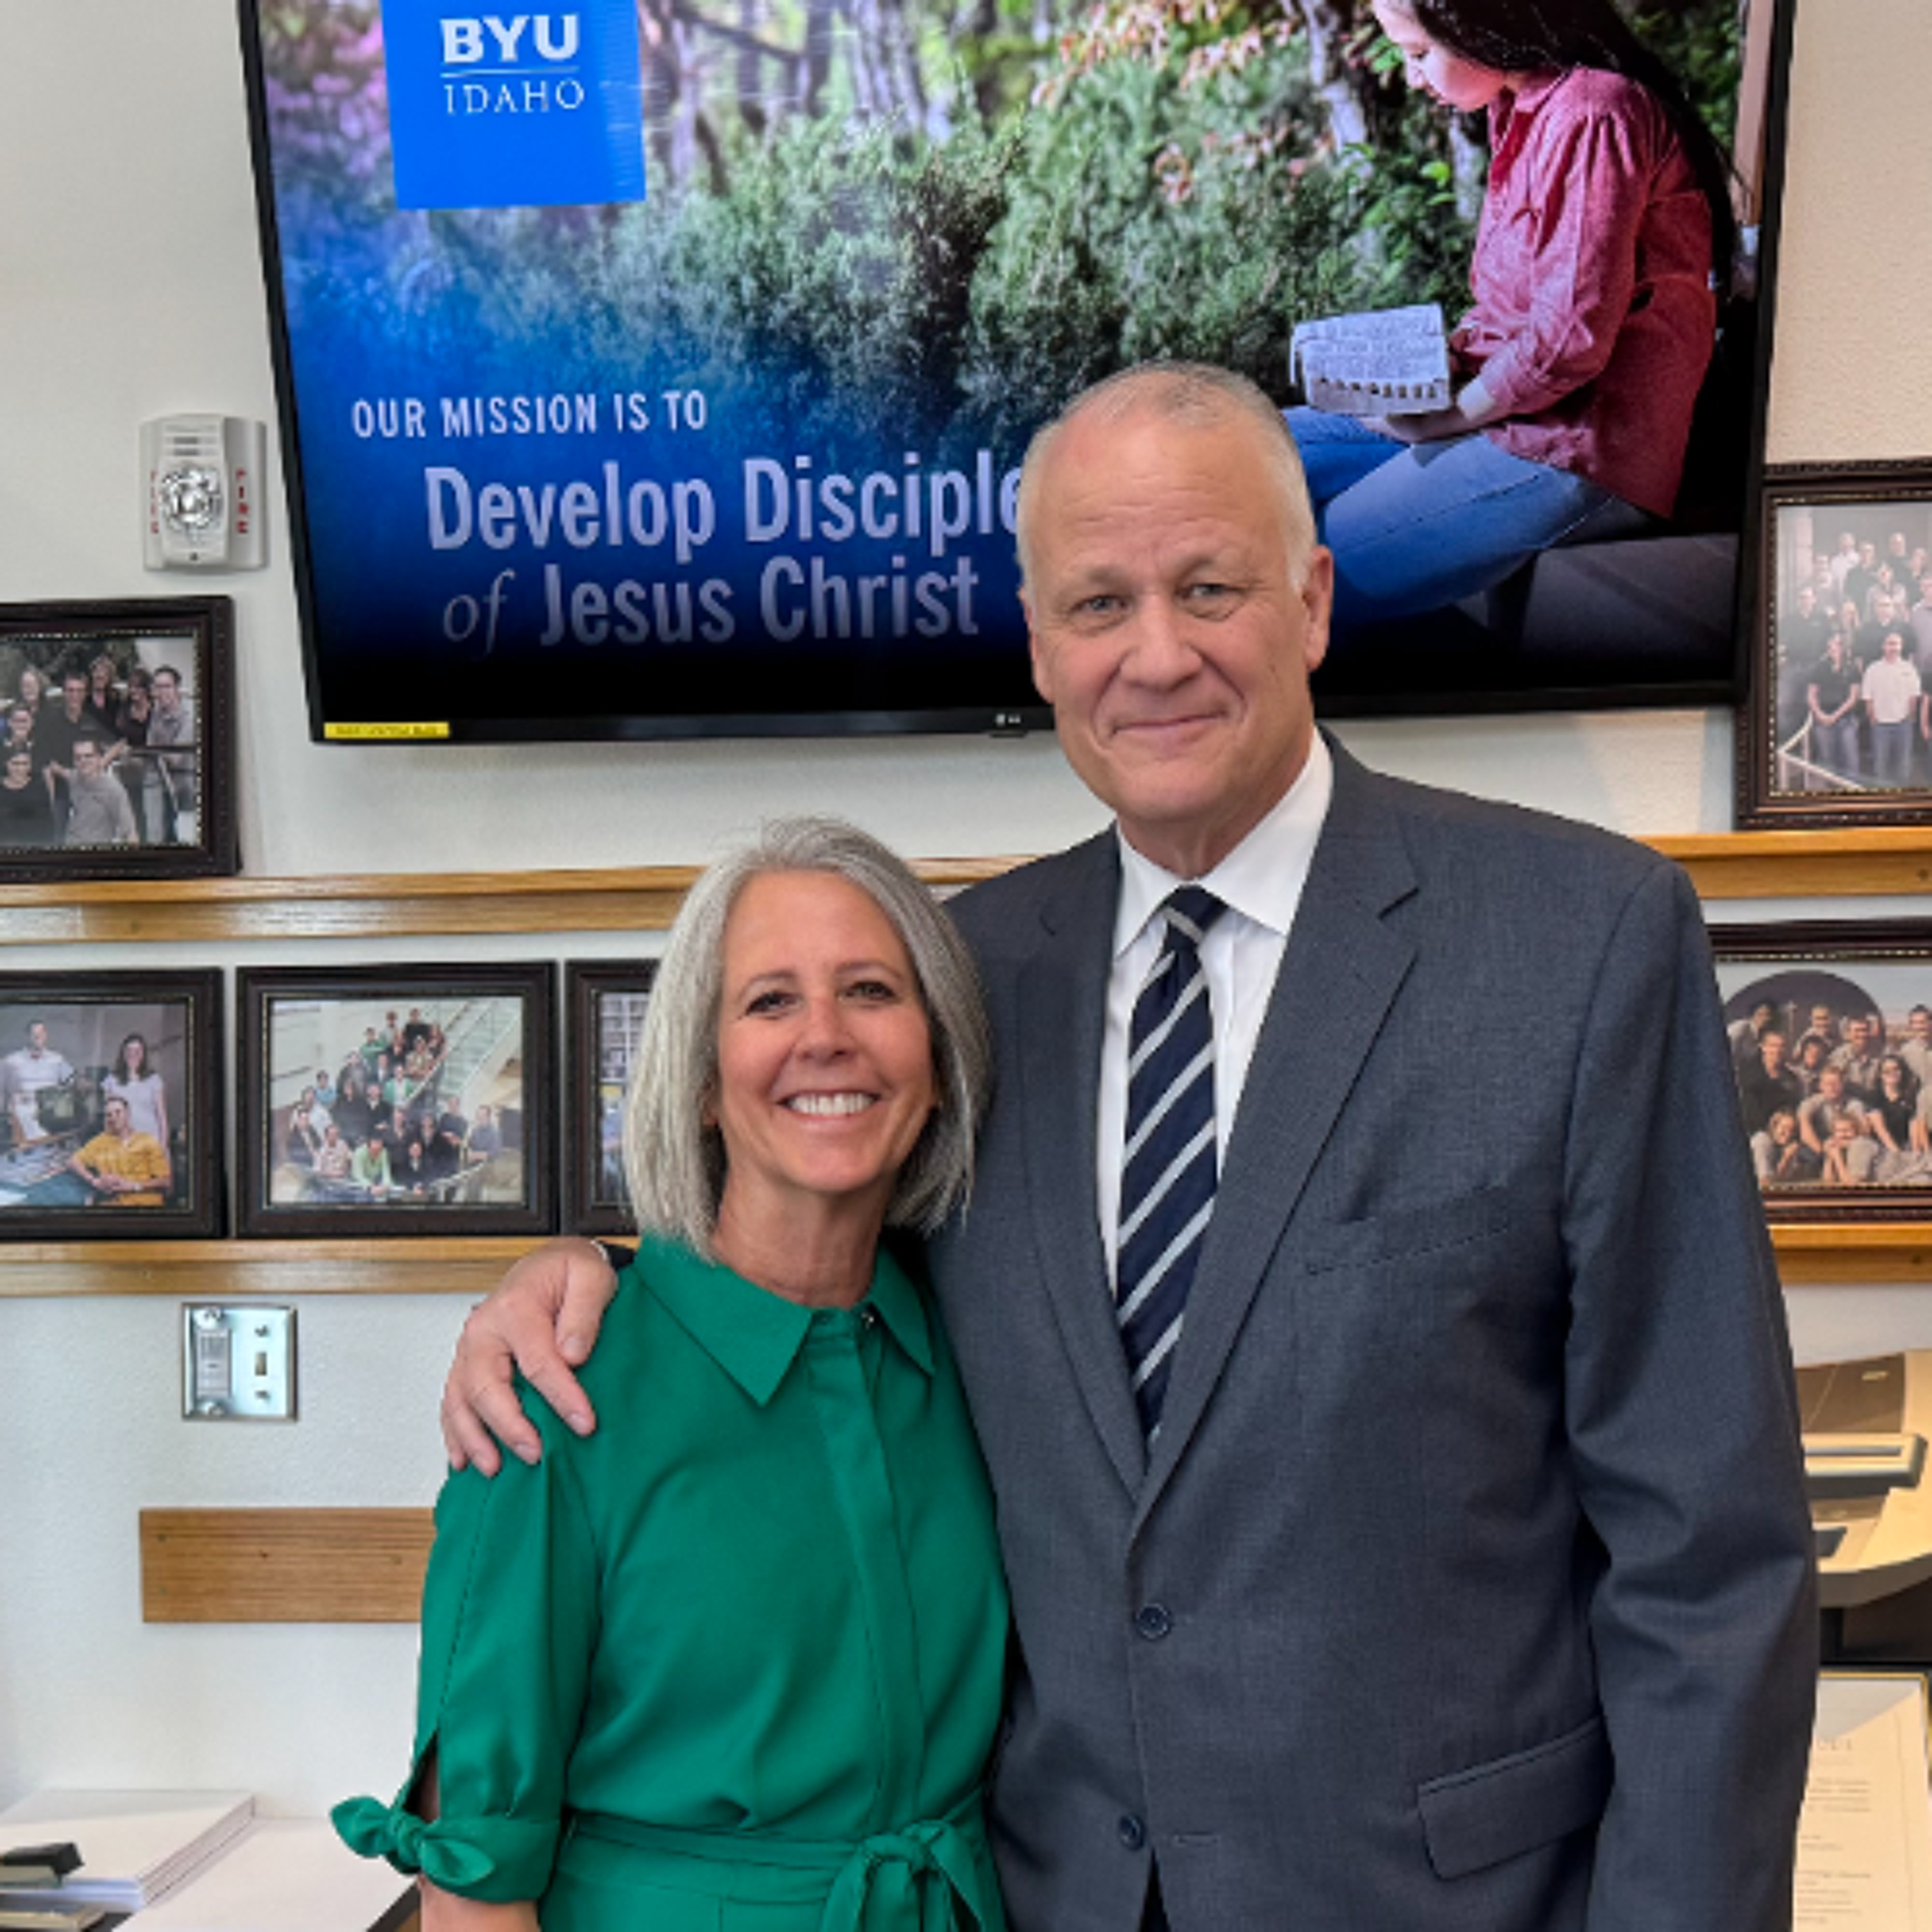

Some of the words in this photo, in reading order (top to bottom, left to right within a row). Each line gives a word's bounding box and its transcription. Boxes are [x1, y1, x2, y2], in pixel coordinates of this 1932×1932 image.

[440, 14, 579, 63] BYU
[444, 78, 585, 115] IDAHO
[352, 399, 426, 438] OUR
[441, 393, 596, 437] MISSION
[614, 392, 649, 433] IS
[661, 390, 707, 431] TO
[424, 460, 715, 565] Develop
[442, 568, 516, 660] of
[540, 563, 735, 645] Jesus
[760, 556, 979, 641] Christ
